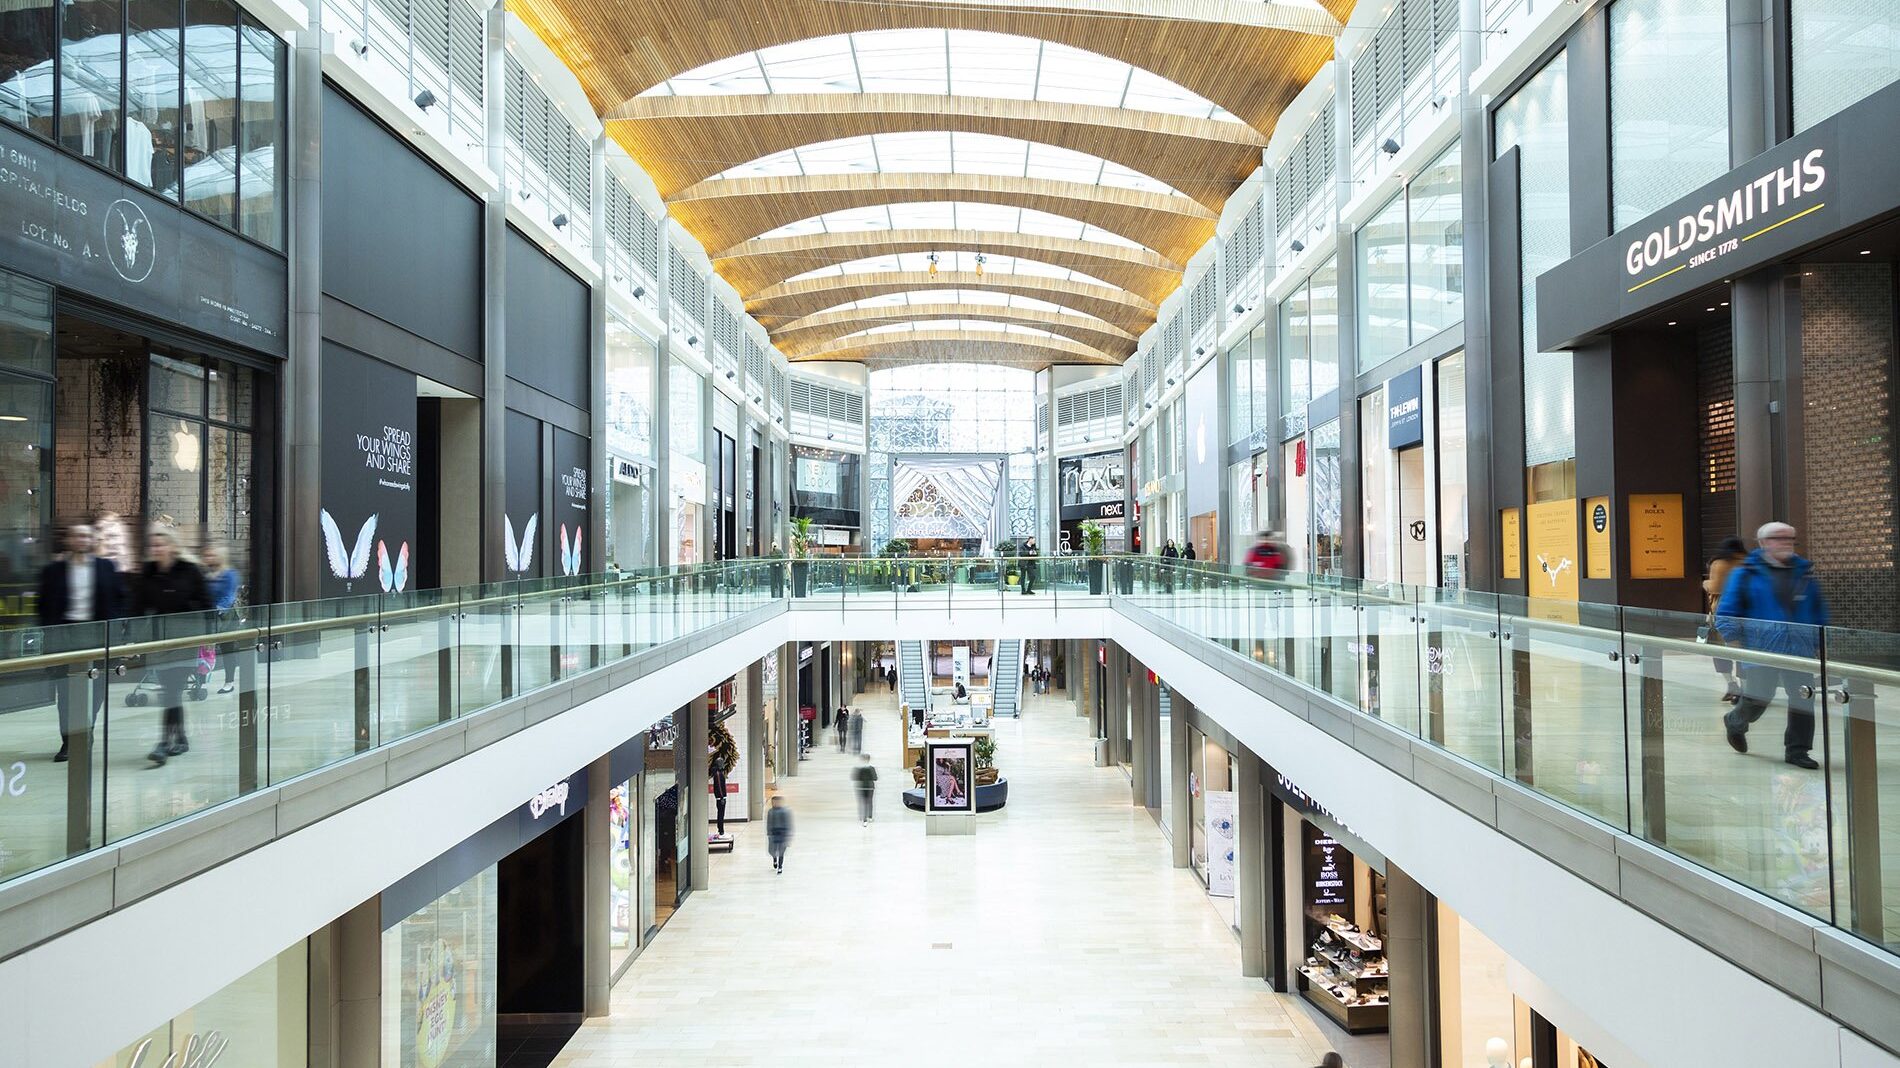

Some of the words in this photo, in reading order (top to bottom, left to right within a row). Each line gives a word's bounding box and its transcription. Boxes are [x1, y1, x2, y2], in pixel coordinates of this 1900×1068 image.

[1626, 149, 1826, 275] GOLDSMITHS
[1689, 247, 1717, 268] SINCE
[1718, 238, 1738, 256] 1778
[357, 434, 380, 454] YOUR
[381, 440, 411, 460] WINGS
[384, 425, 411, 446] SPREAD
[366, 452, 386, 470] AND
[387, 456, 411, 475] SHARE
[806, 464, 828, 476] NEW
[804, 477, 832, 488] LOOK
[1065, 464, 1120, 495] next
[1100, 504, 1123, 516] next
